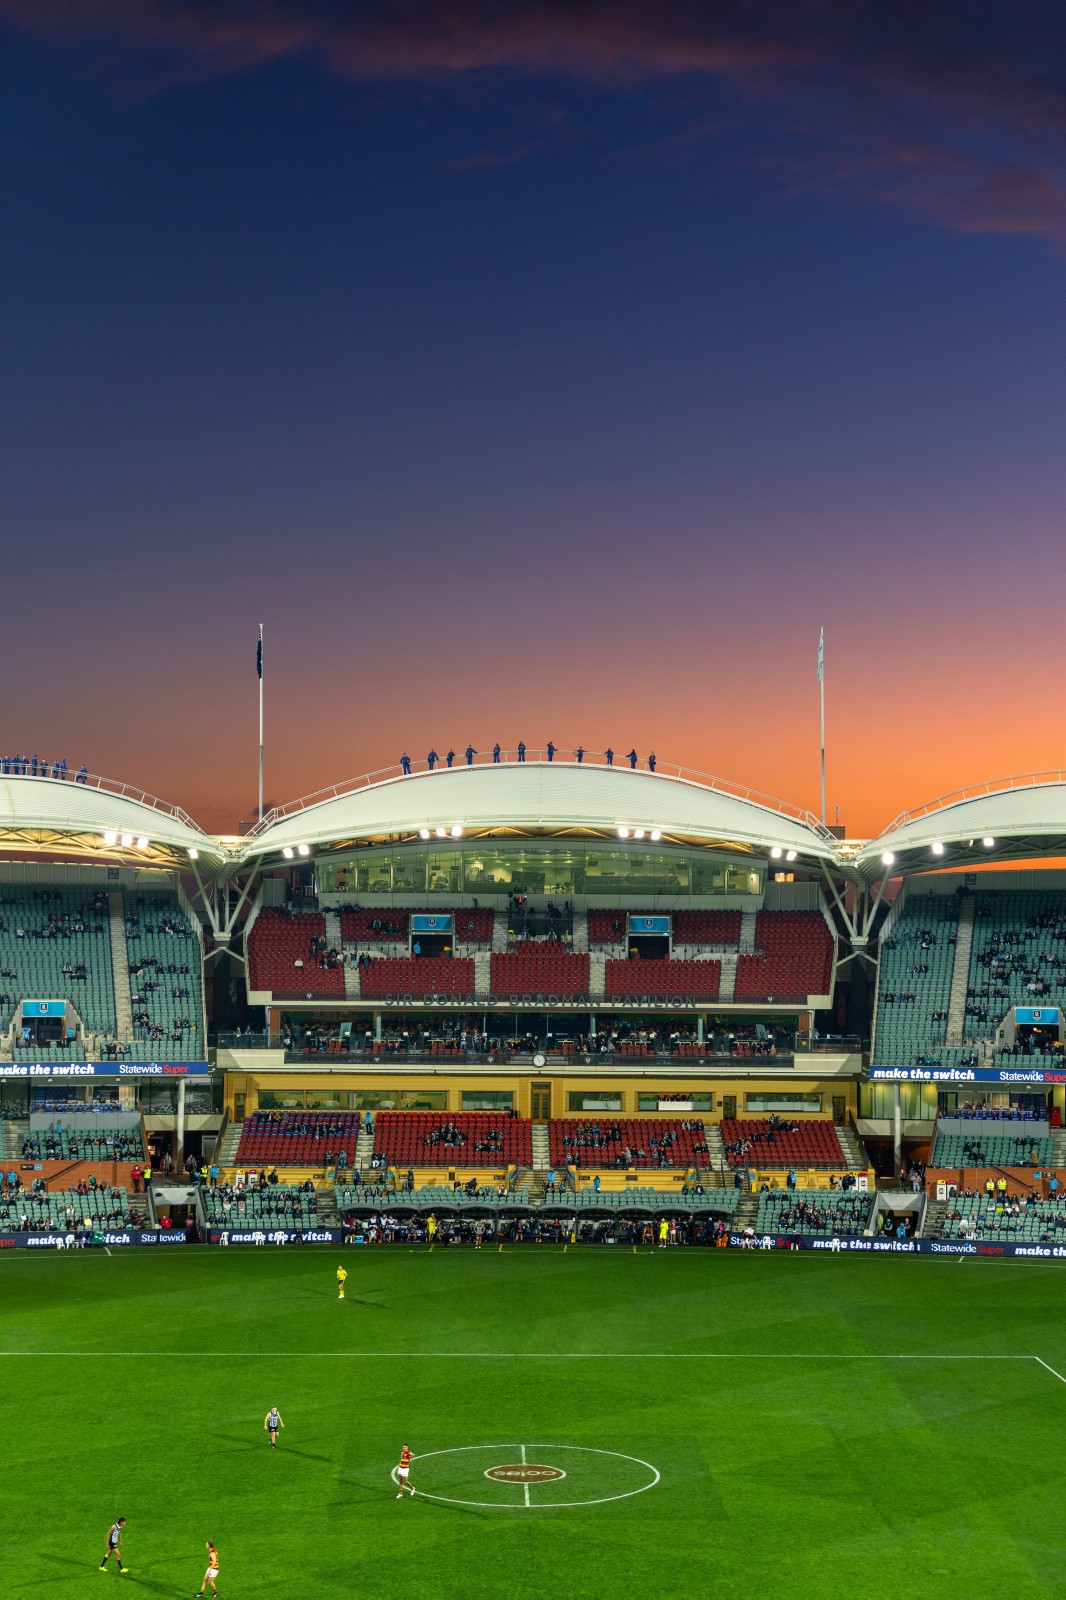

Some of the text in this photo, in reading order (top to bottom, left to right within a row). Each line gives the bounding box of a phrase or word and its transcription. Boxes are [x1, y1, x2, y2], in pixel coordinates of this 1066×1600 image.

[385, 994, 696, 1008] SIR DONALD BRADMAN PAVILION
[0, 1063, 95, 1075] ake the switch
[119, 1063, 189, 1075] Statewide Super
[873, 1068, 975, 1080] make the switch
[1000, 1070, 1044, 1081] Statewide
[849, 1240, 871, 1249] the
[873, 1240, 921, 1251] switch
[931, 1243, 1005, 1255] Statewide Super
[1015, 1246, 1051, 1256] make
